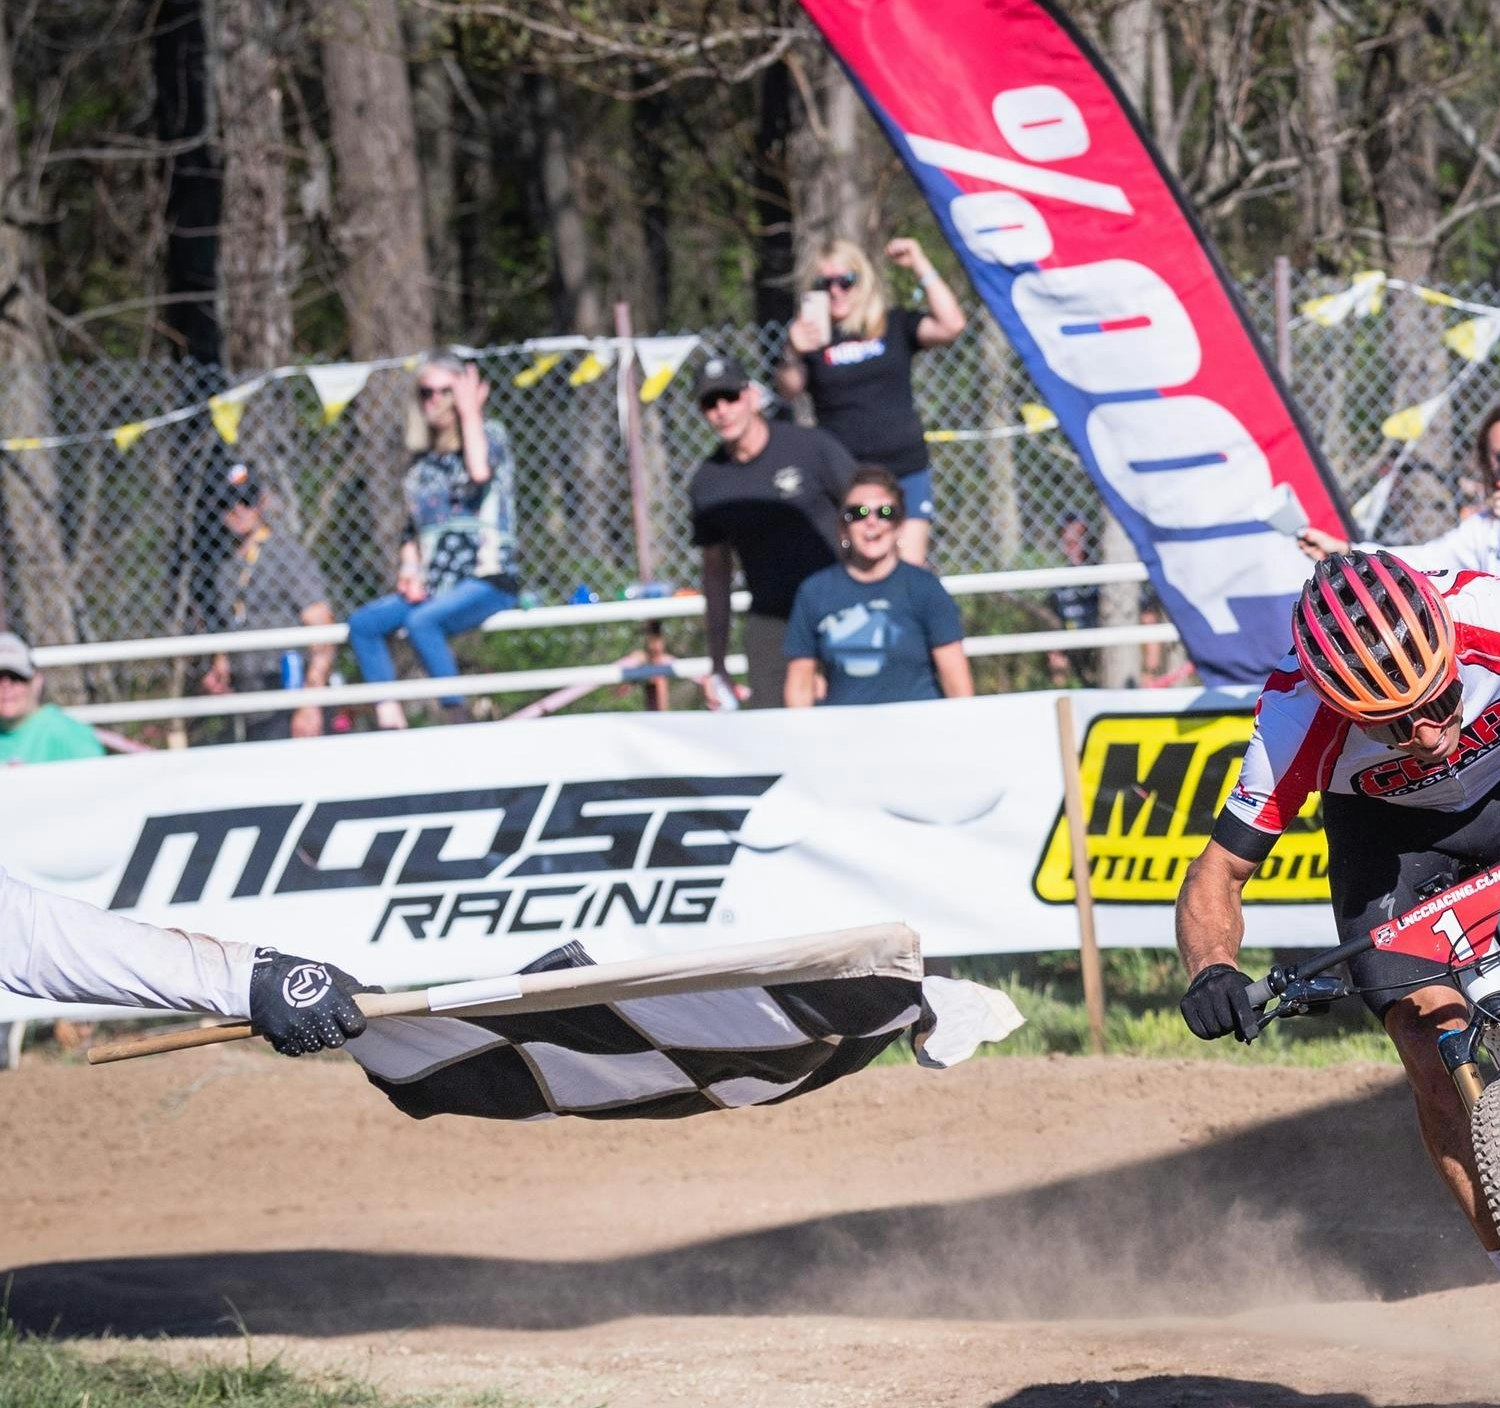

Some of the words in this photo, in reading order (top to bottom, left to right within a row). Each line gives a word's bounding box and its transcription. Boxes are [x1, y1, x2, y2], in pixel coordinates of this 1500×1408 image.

[904, 85, 1316, 635] 100%
[107, 773, 783, 911] MOOSE
[370, 877, 726, 943] RACING
[1431, 907, 1476, 963] 1
